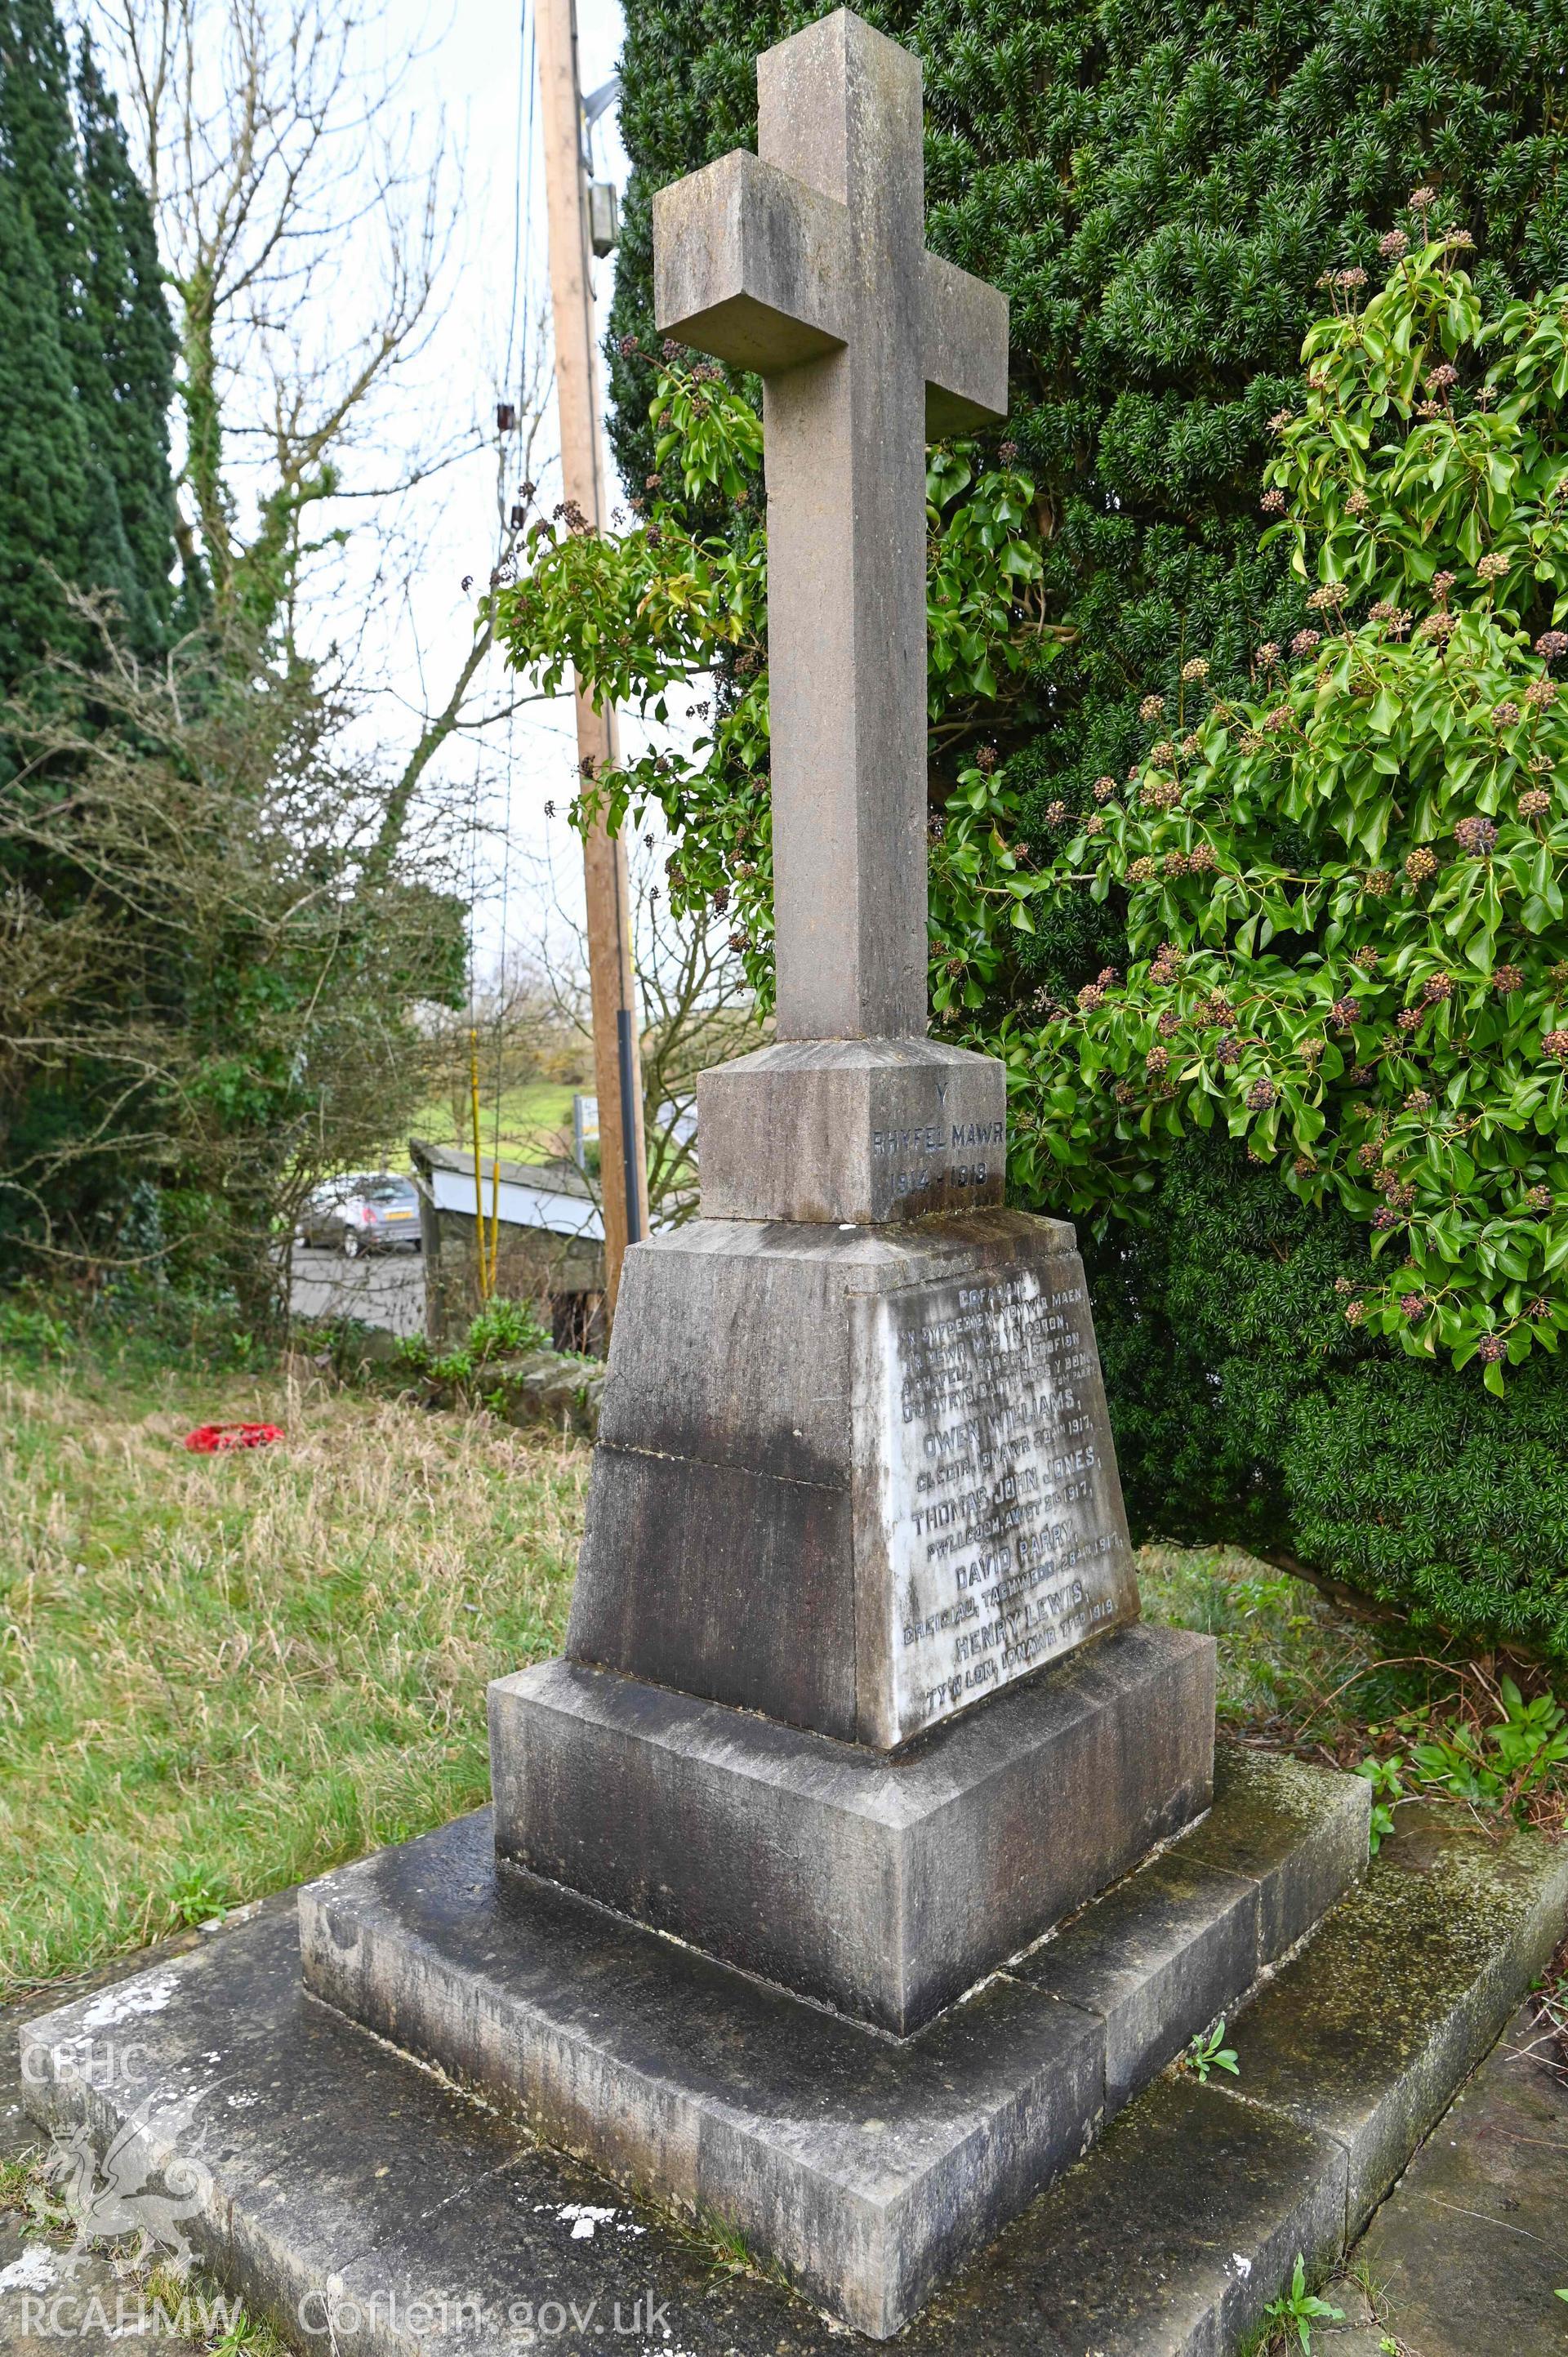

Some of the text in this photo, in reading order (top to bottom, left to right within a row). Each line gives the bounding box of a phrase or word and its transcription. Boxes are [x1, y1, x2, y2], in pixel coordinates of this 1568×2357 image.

[873, 1121, 1003, 1154] RHYFEL MAWR
[891, 1170, 929, 1196] 1914
[951, 1163, 988, 1187] 1918
[1052, 1373, 1070, 1386] TOM
[1054, 1359, 1061, 1373] Y
[924, 1388, 1081, 1459] OWEN WILLIAMS,
[978, 1435, 1030, 1473] IONAWR
[911, 1445, 1102, 1535] THOMAS JOHN JONES,
[956, 1519, 1078, 1591] DAVID PARRY,
[956, 1580, 1090, 1663] HENRY LEWIS,
[926, 1674, 962, 1711] TY'N
[1001, 1627, 1058, 1669] IONAWR
